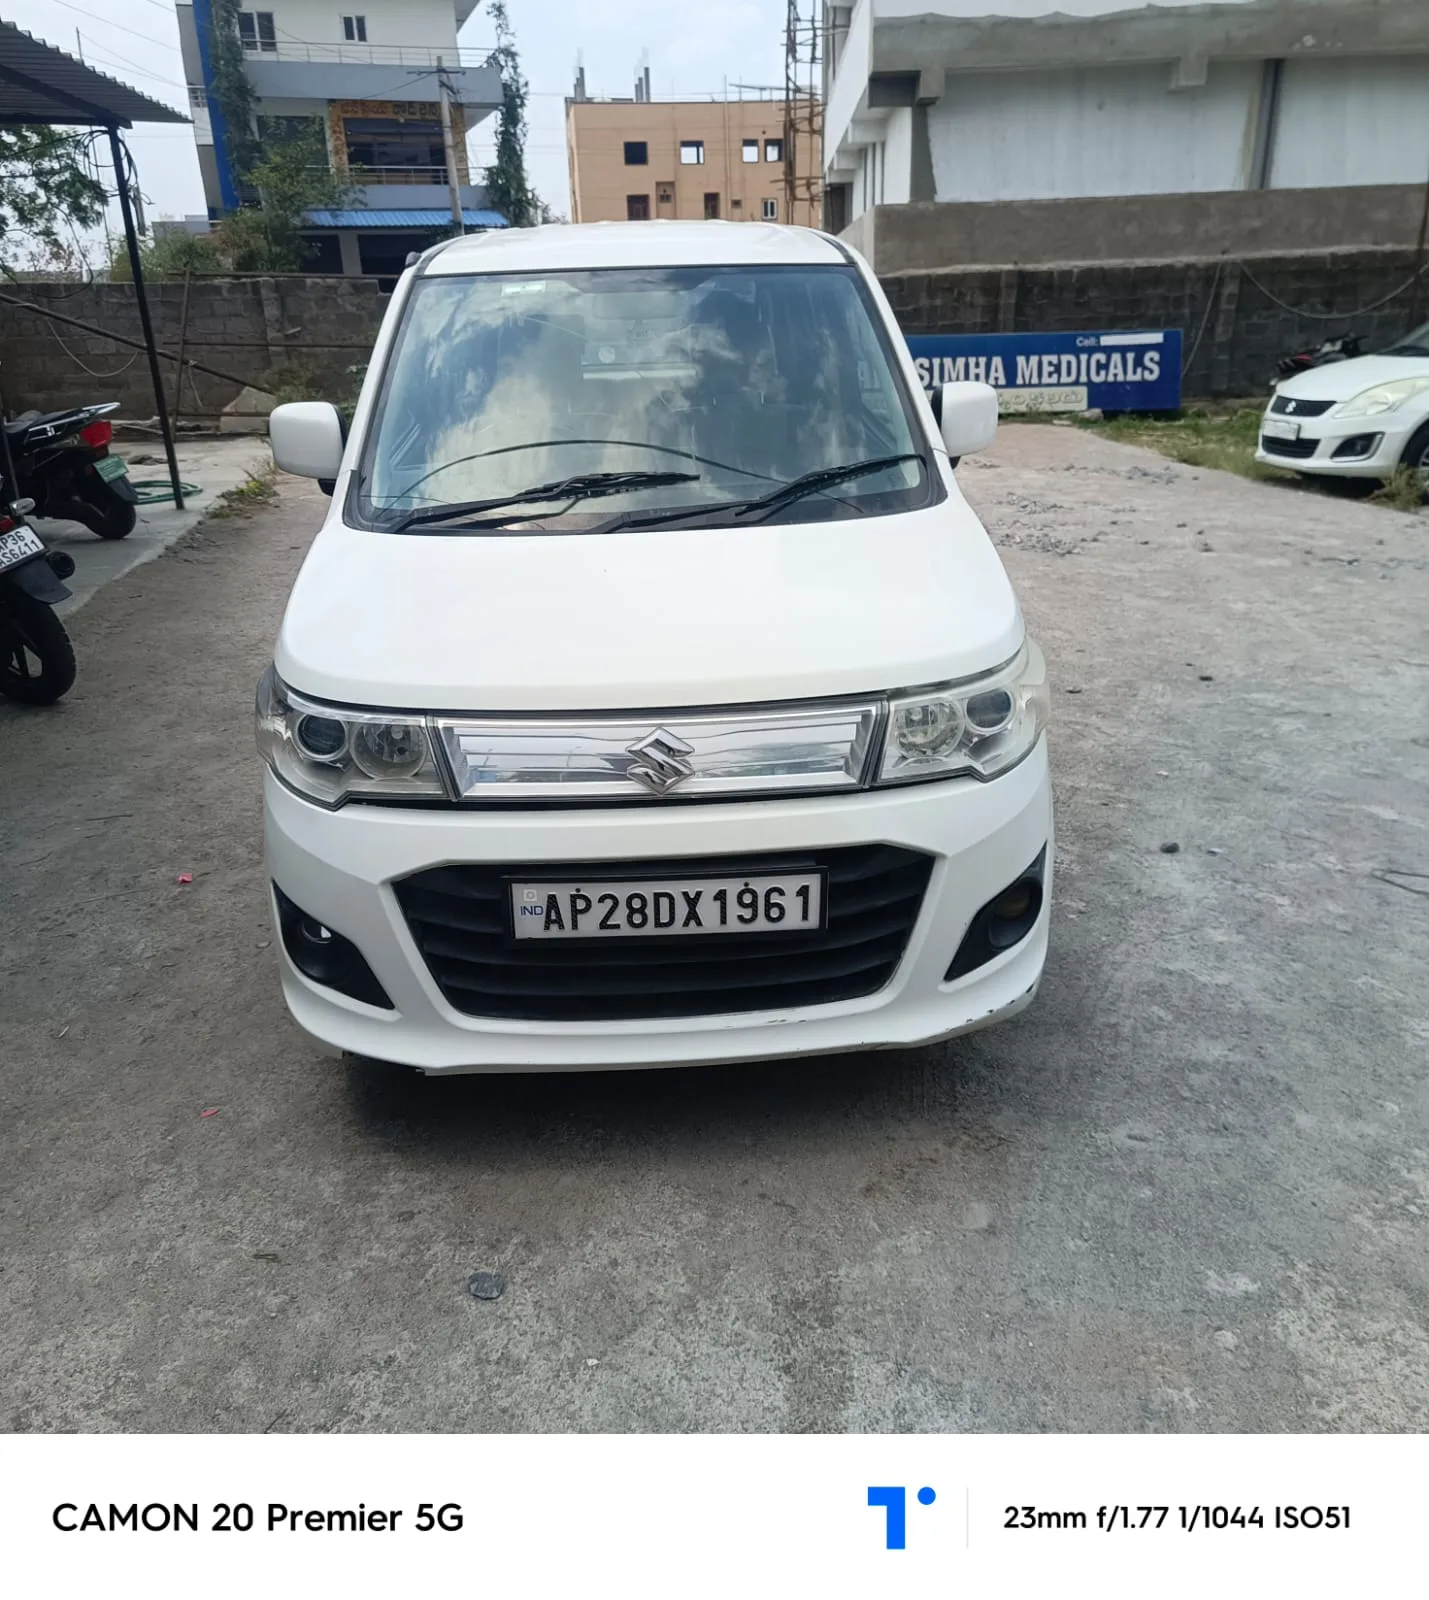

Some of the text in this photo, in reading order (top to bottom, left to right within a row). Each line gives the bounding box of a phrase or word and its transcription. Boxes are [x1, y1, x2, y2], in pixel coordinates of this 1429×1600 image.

[1015, 351, 1161, 385] MEDICALS
[520, 904, 544, 916] IND
[543, 883, 812, 931] AP28DX1961
